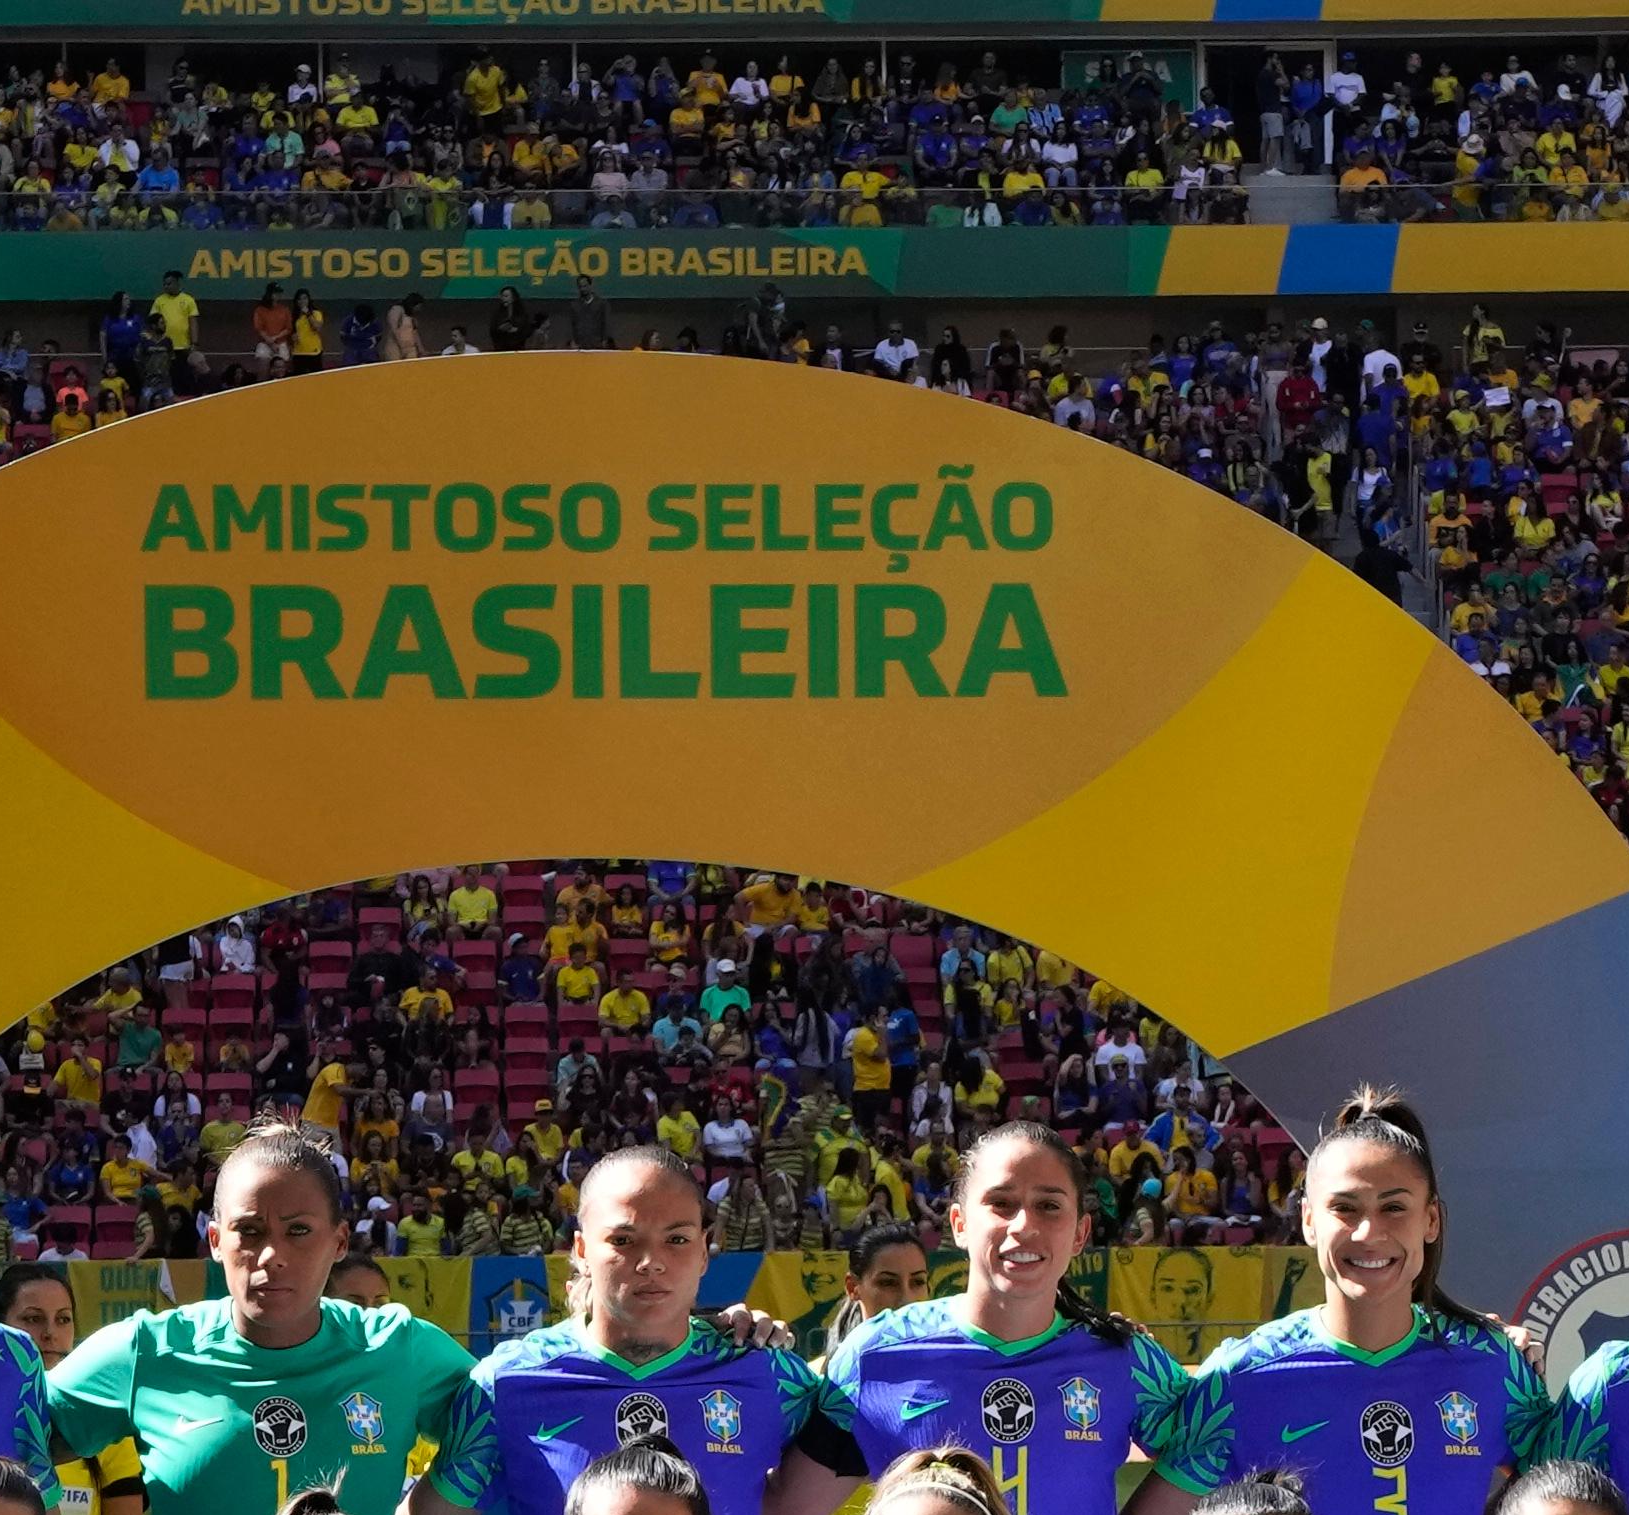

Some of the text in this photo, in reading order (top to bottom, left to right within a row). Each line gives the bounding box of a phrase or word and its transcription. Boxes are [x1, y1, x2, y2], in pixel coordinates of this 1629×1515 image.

[187, 240, 867, 286] AMISTOSO SELEÇÃO BRASILEIRA
[141, 465, 1053, 572] AMISTOSO SELEÇÃO
[144, 582, 1069, 700] BRASILEIRA
[508, 1316, 535, 1328] CBF
[1064, 1430, 1102, 1441] BRASIL
[351, 1444, 387, 1455] BRASIL
[706, 1442, 744, 1454] BRASIL
[1444, 1444, 1481, 1456] BRASIL
